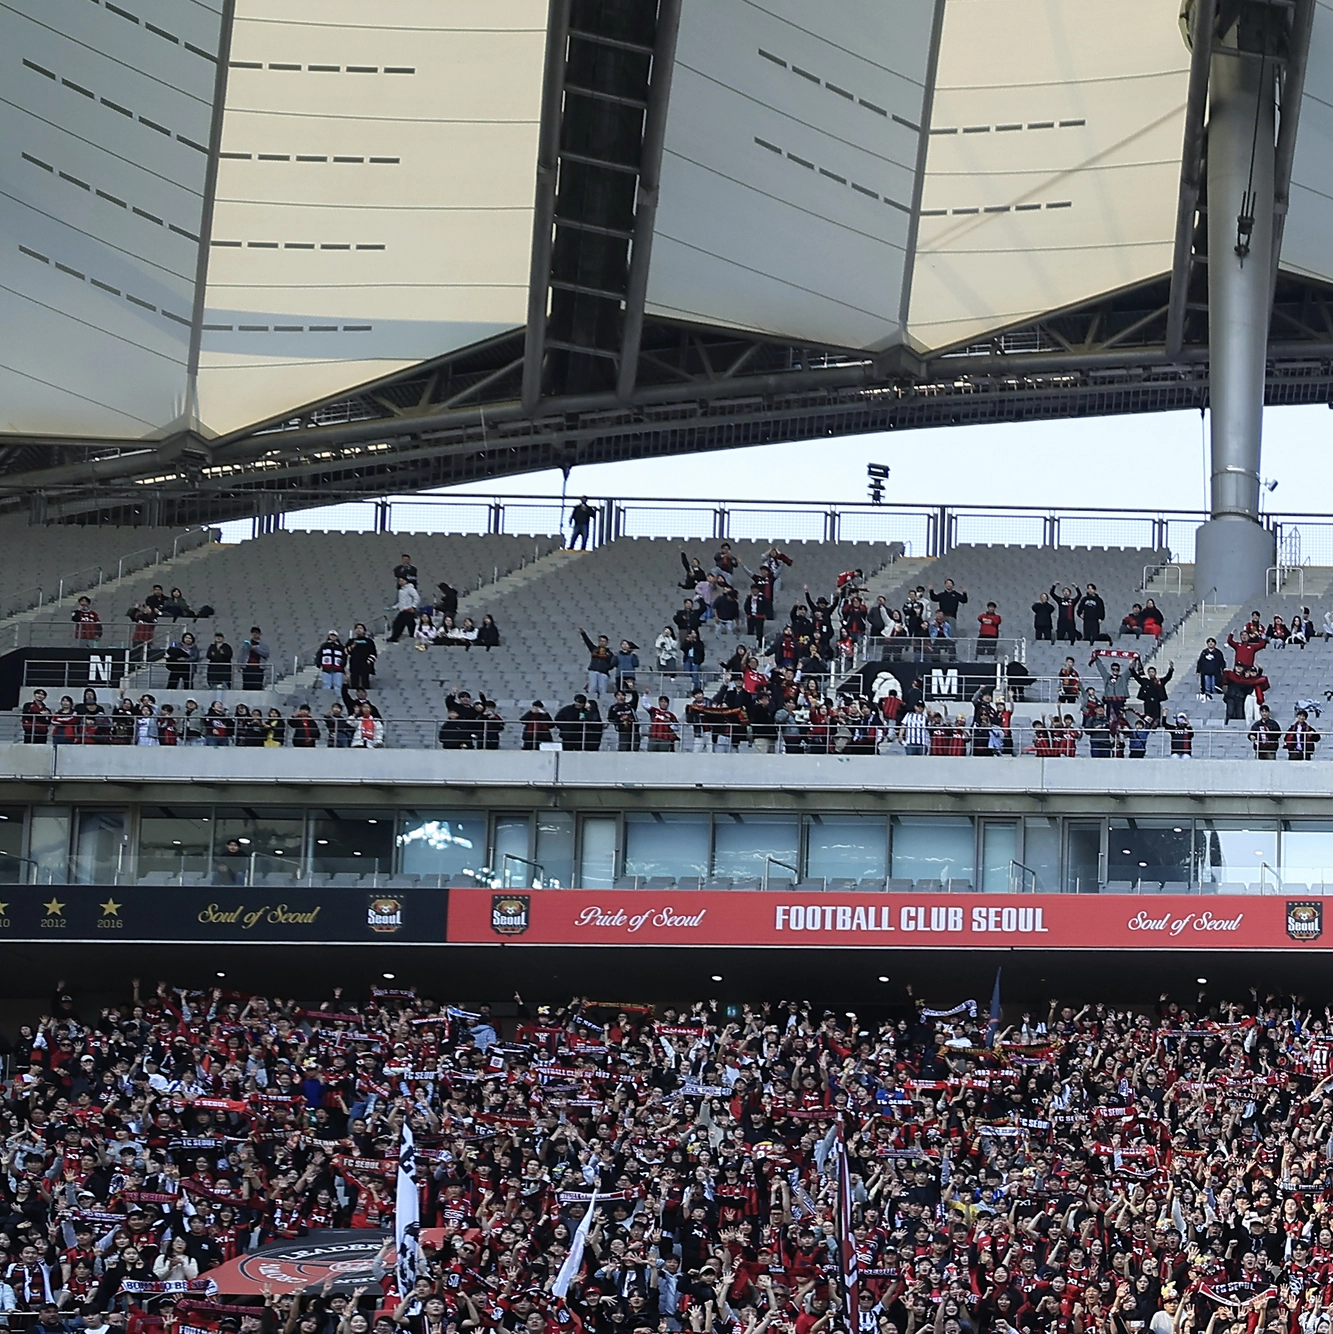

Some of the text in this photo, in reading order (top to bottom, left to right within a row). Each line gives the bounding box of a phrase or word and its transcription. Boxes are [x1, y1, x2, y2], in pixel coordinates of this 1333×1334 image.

[931, 668, 959, 696] M
[40, 918, 123, 929] 2012 2016
[198, 904, 321, 930] Soul of Seoul
[574, 906, 706, 932] Pride of Seoul
[774, 905, 1048, 933] FOOTBALL CLUB SEOUL
[1127, 911, 1243, 937] Soul of Seoul
